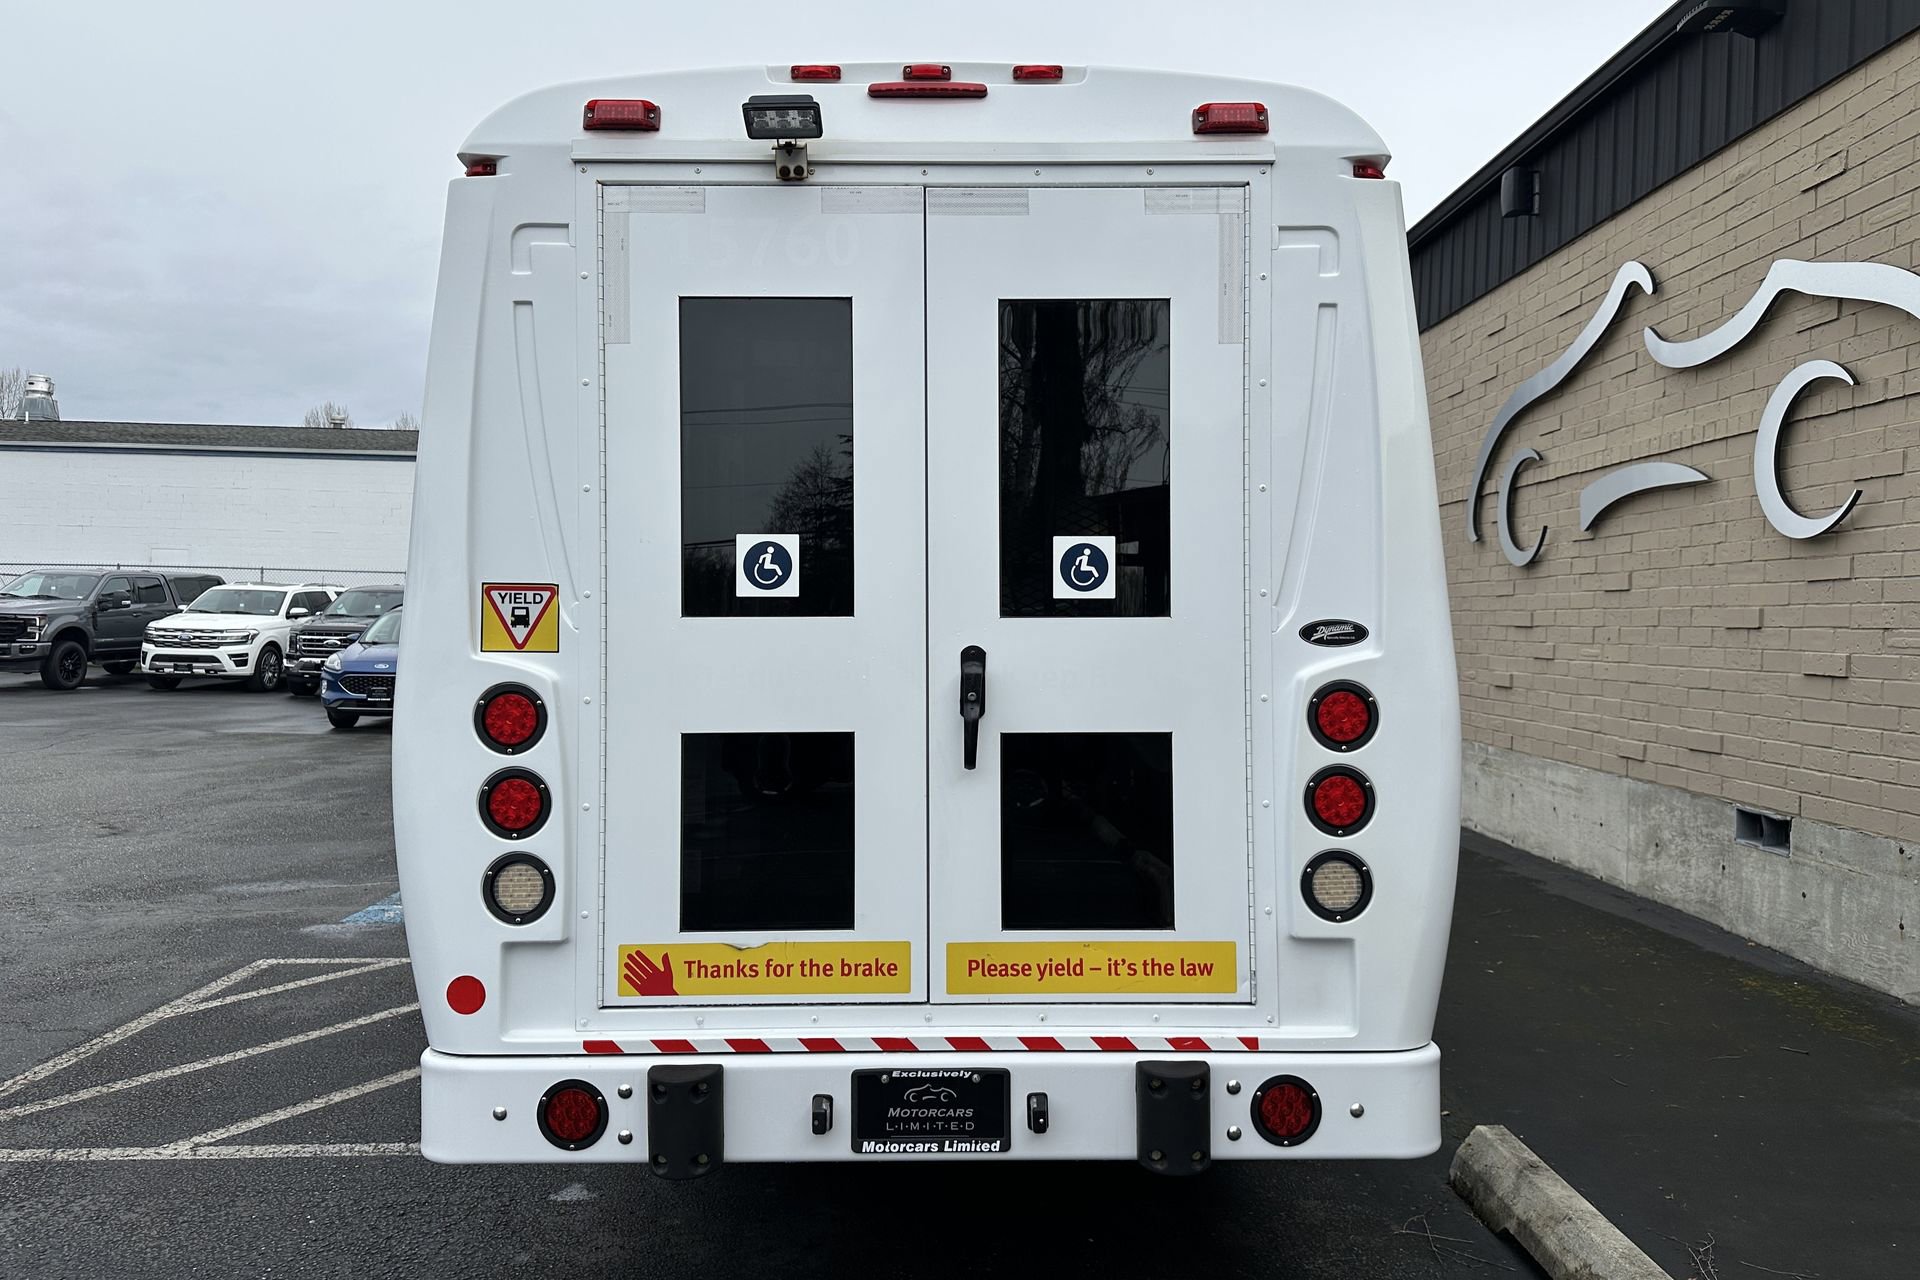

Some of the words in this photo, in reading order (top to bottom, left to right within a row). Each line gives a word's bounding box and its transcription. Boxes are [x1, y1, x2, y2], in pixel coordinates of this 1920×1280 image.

[498, 592, 544, 605] YIELD
[1313, 623, 1354, 640] Dynamic
[683, 958, 759, 979] Thanks
[765, 958, 794, 978] for
[800, 958, 834, 977] the
[840, 957, 898, 977] brake
[967, 959, 1032, 978] Please
[1036, 958, 1084, 982] yield
[1142, 958, 1175, 977] the
[1180, 958, 1214, 977] law
[891, 1070, 972, 1079] Exclusively
[887, 1108, 974, 1118] MOTORCARS
[861, 1140, 939, 1153] Motorcars
[943, 1140, 1001, 1152] Limited
